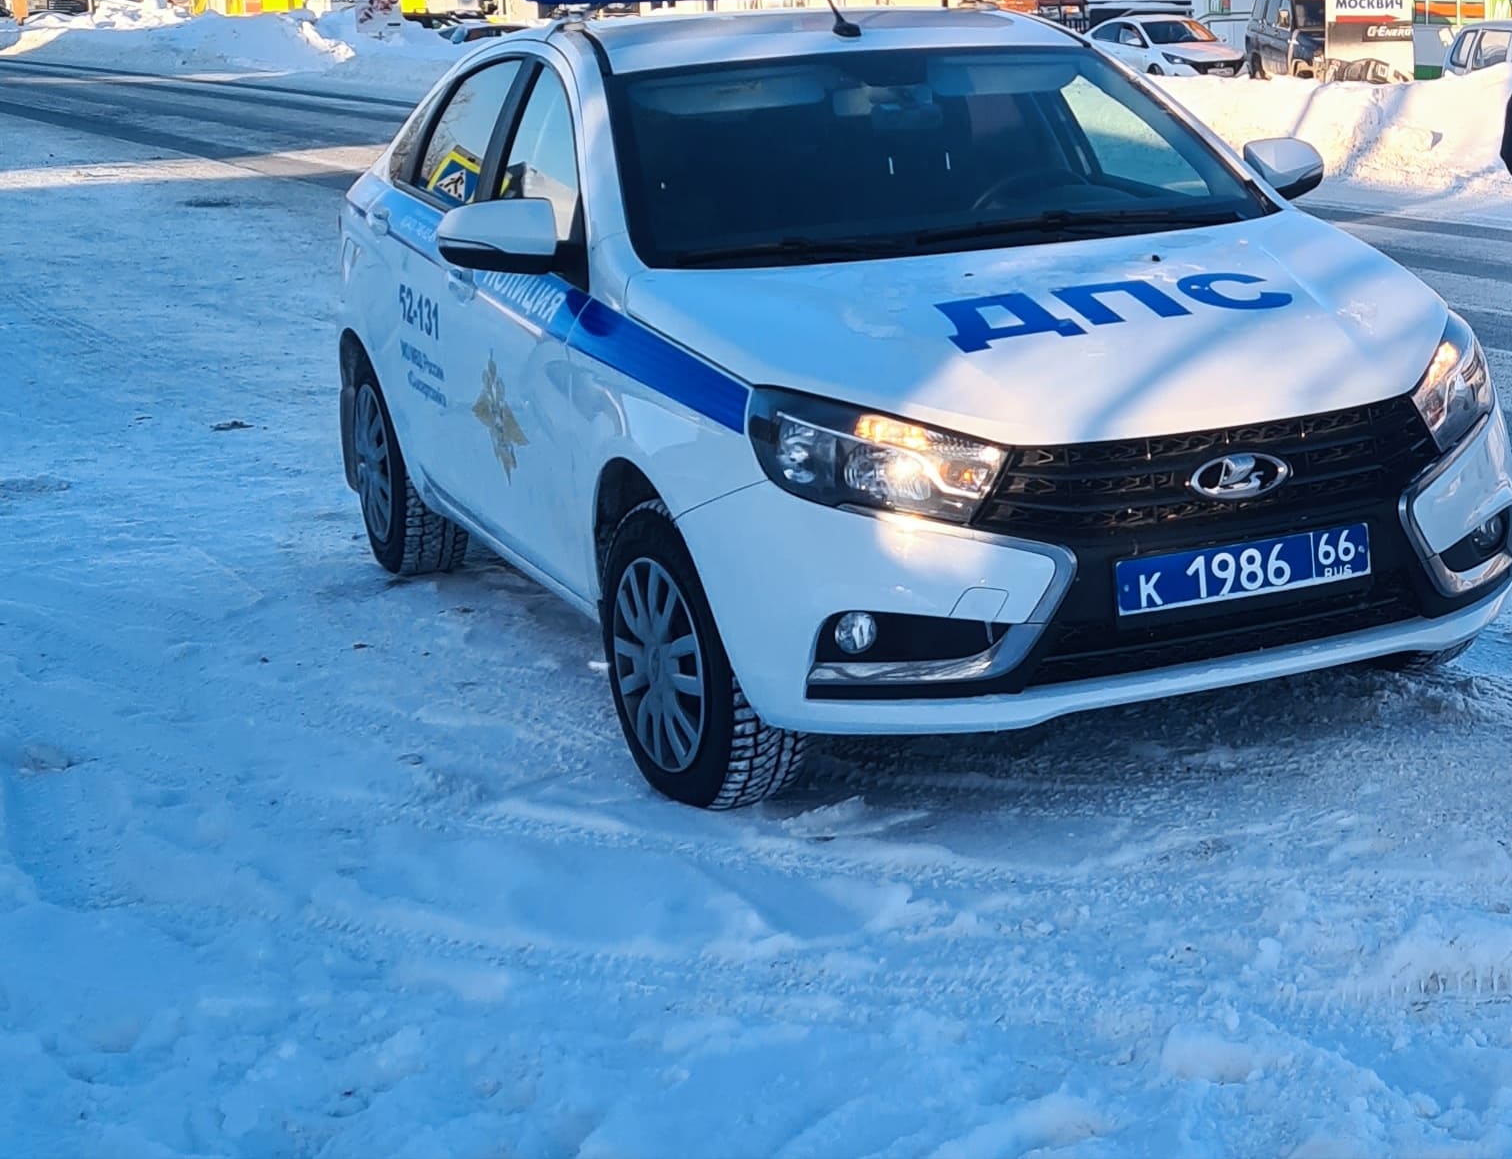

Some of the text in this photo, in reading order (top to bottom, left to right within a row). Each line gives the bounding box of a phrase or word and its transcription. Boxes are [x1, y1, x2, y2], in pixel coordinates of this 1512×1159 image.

[399, 284, 439, 340] 52-131
[933, 272, 1293, 354] ДПС
[1186, 543, 1291, 598] 1986
[1318, 530, 1356, 565] 66
[1324, 564, 1353, 578] RUS
